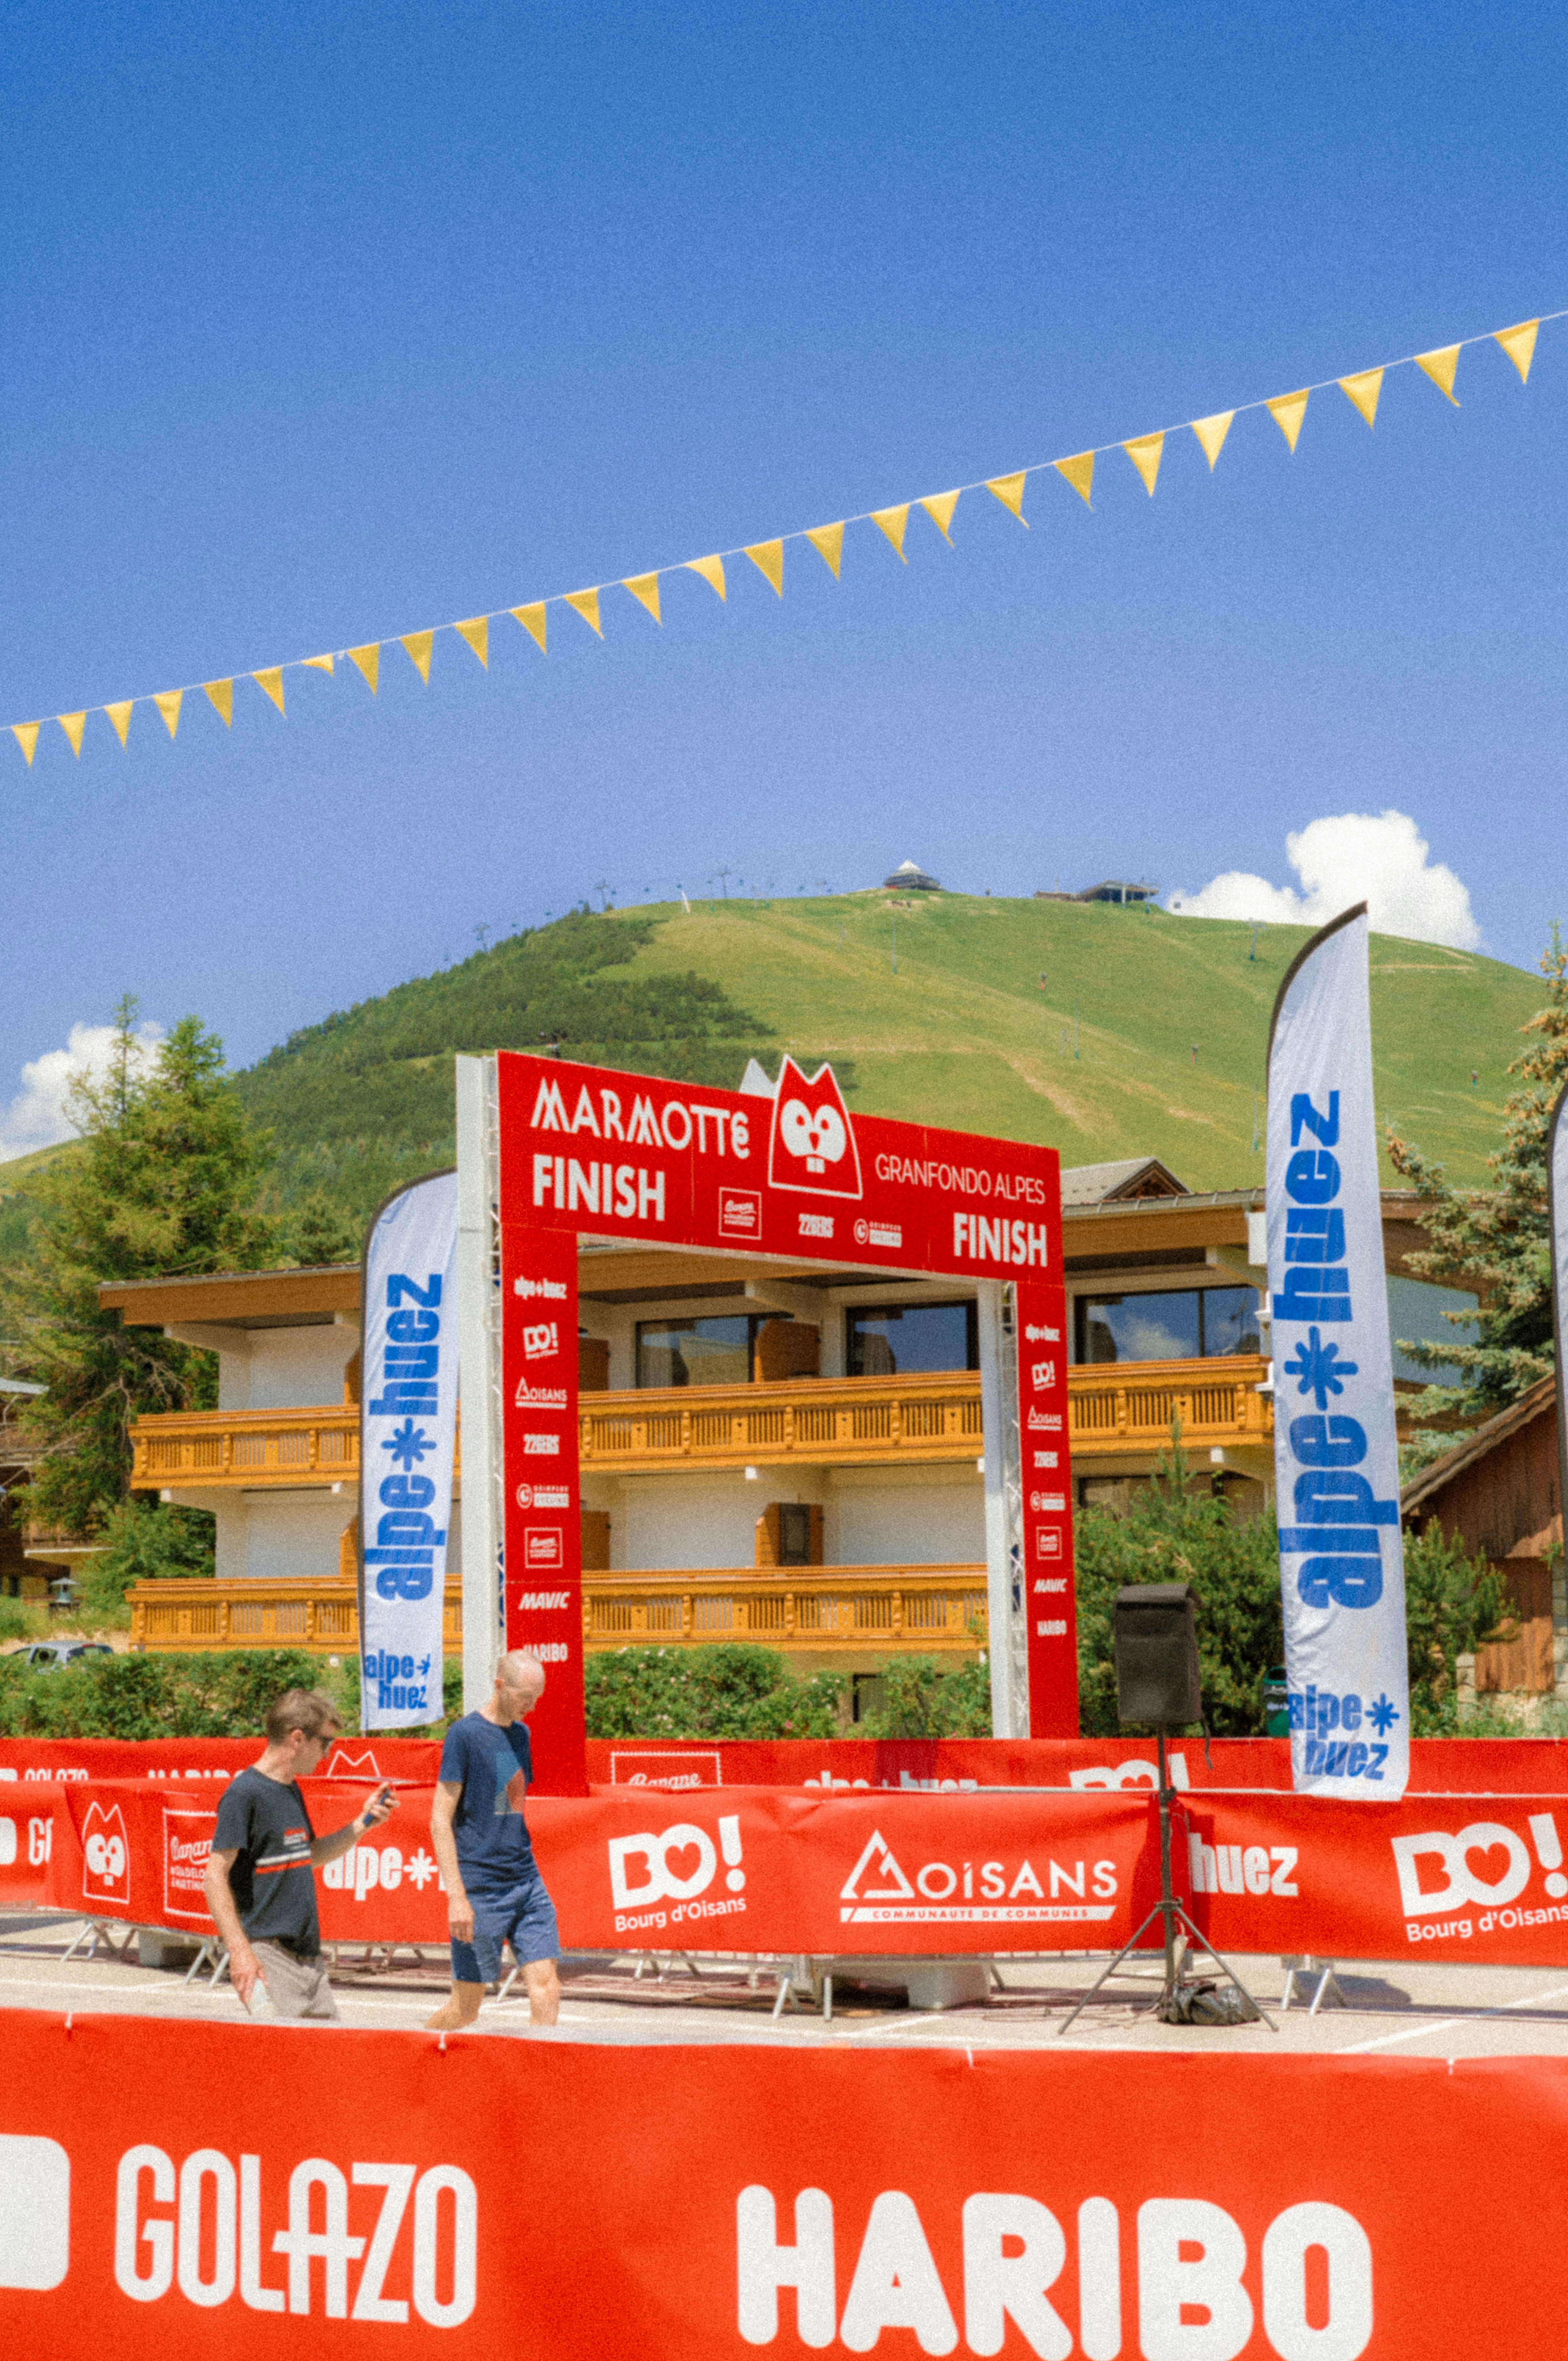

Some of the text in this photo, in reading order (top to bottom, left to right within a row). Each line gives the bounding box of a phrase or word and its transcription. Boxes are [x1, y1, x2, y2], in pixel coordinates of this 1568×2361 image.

[534, 1154, 664, 1220] FINISH
[876, 1155, 1043, 1203] GRANFONDO ALPES
[954, 1213, 1046, 1266] FINISH
[1272, 1090, 1398, 1609] alpe huez
[364, 1274, 446, 1600] alpe huez
[518, 1592, 570, 1610] MAVIC
[365, 1649, 414, 1684] alpe
[378, 1679, 427, 1710] huez
[1287, 1685, 1361, 1739] alpe
[1306, 1733, 1389, 1780] huez
[323, 1844, 403, 1901] alpe
[608, 1814, 746, 1910] BO!
[1190, 1834, 1298, 1896] huez
[1391, 1813, 1568, 1917] BO!
[615, 1897, 746, 1932] Bourg d'Oisans
[983, 1910, 998, 1918] DE
[1006, 1909, 1088, 1918] COMMUNES
[1406, 1905, 1568, 1942] Bourg d'Oisans
[114, 2144, 477, 2328] GOLAZO
[736, 2184, 1374, 2361] HARIBO
